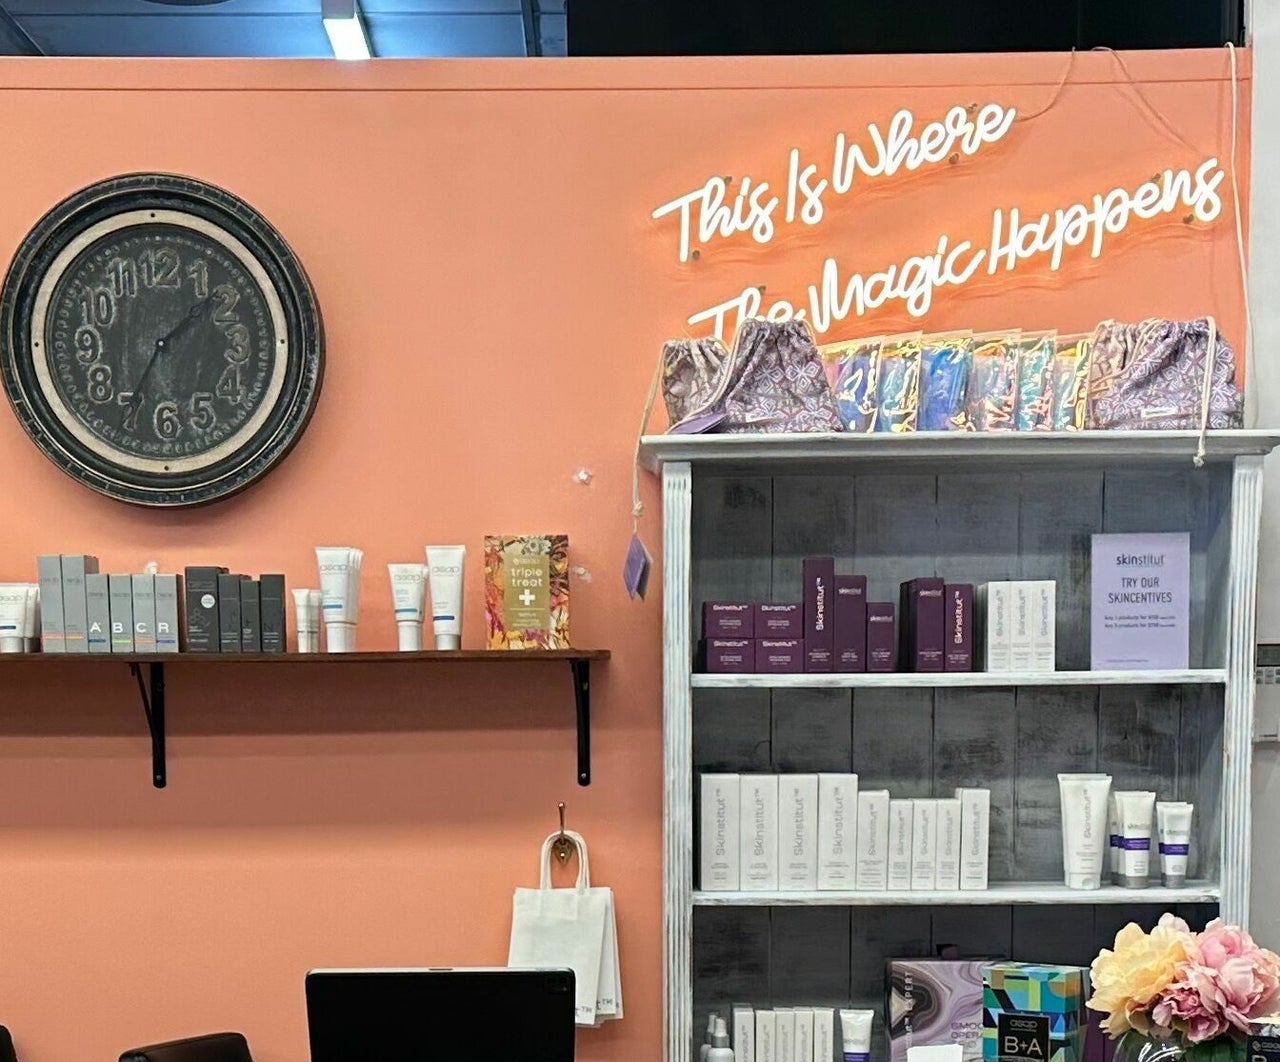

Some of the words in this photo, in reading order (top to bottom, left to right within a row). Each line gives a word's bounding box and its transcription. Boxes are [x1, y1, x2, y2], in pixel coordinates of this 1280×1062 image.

[651, 176, 780, 263] This
[785, 148, 829, 225] Is
[832, 103, 1017, 194] Where
[808, 234, 987, 333] Magic
[987, 157, 1225, 275] Happens
[137, 247, 181, 288] 12
[187, 259, 208, 298] 1
[212, 284, 241, 325] 2
[74, 325, 103, 365] 9
[224, 324, 252, 365] 3
[88, 364, 114, 403] 8
[215, 364, 243, 405] 4
[153, 401, 183, 440] 6
[190, 392, 216, 430] 5
[510, 568, 543, 577] triple
[511, 578, 543, 587] treat
[1121, 577, 1138, 588] TRY
[1141, 577, 1160, 588] OUR
[1107, 591, 1173, 604] SKINCENTIVES
[112, 622, 124, 633] B
[136, 622, 147, 633] C
[158, 622, 169, 633] R
[1004, 1035, 1043, 1056] B+A
